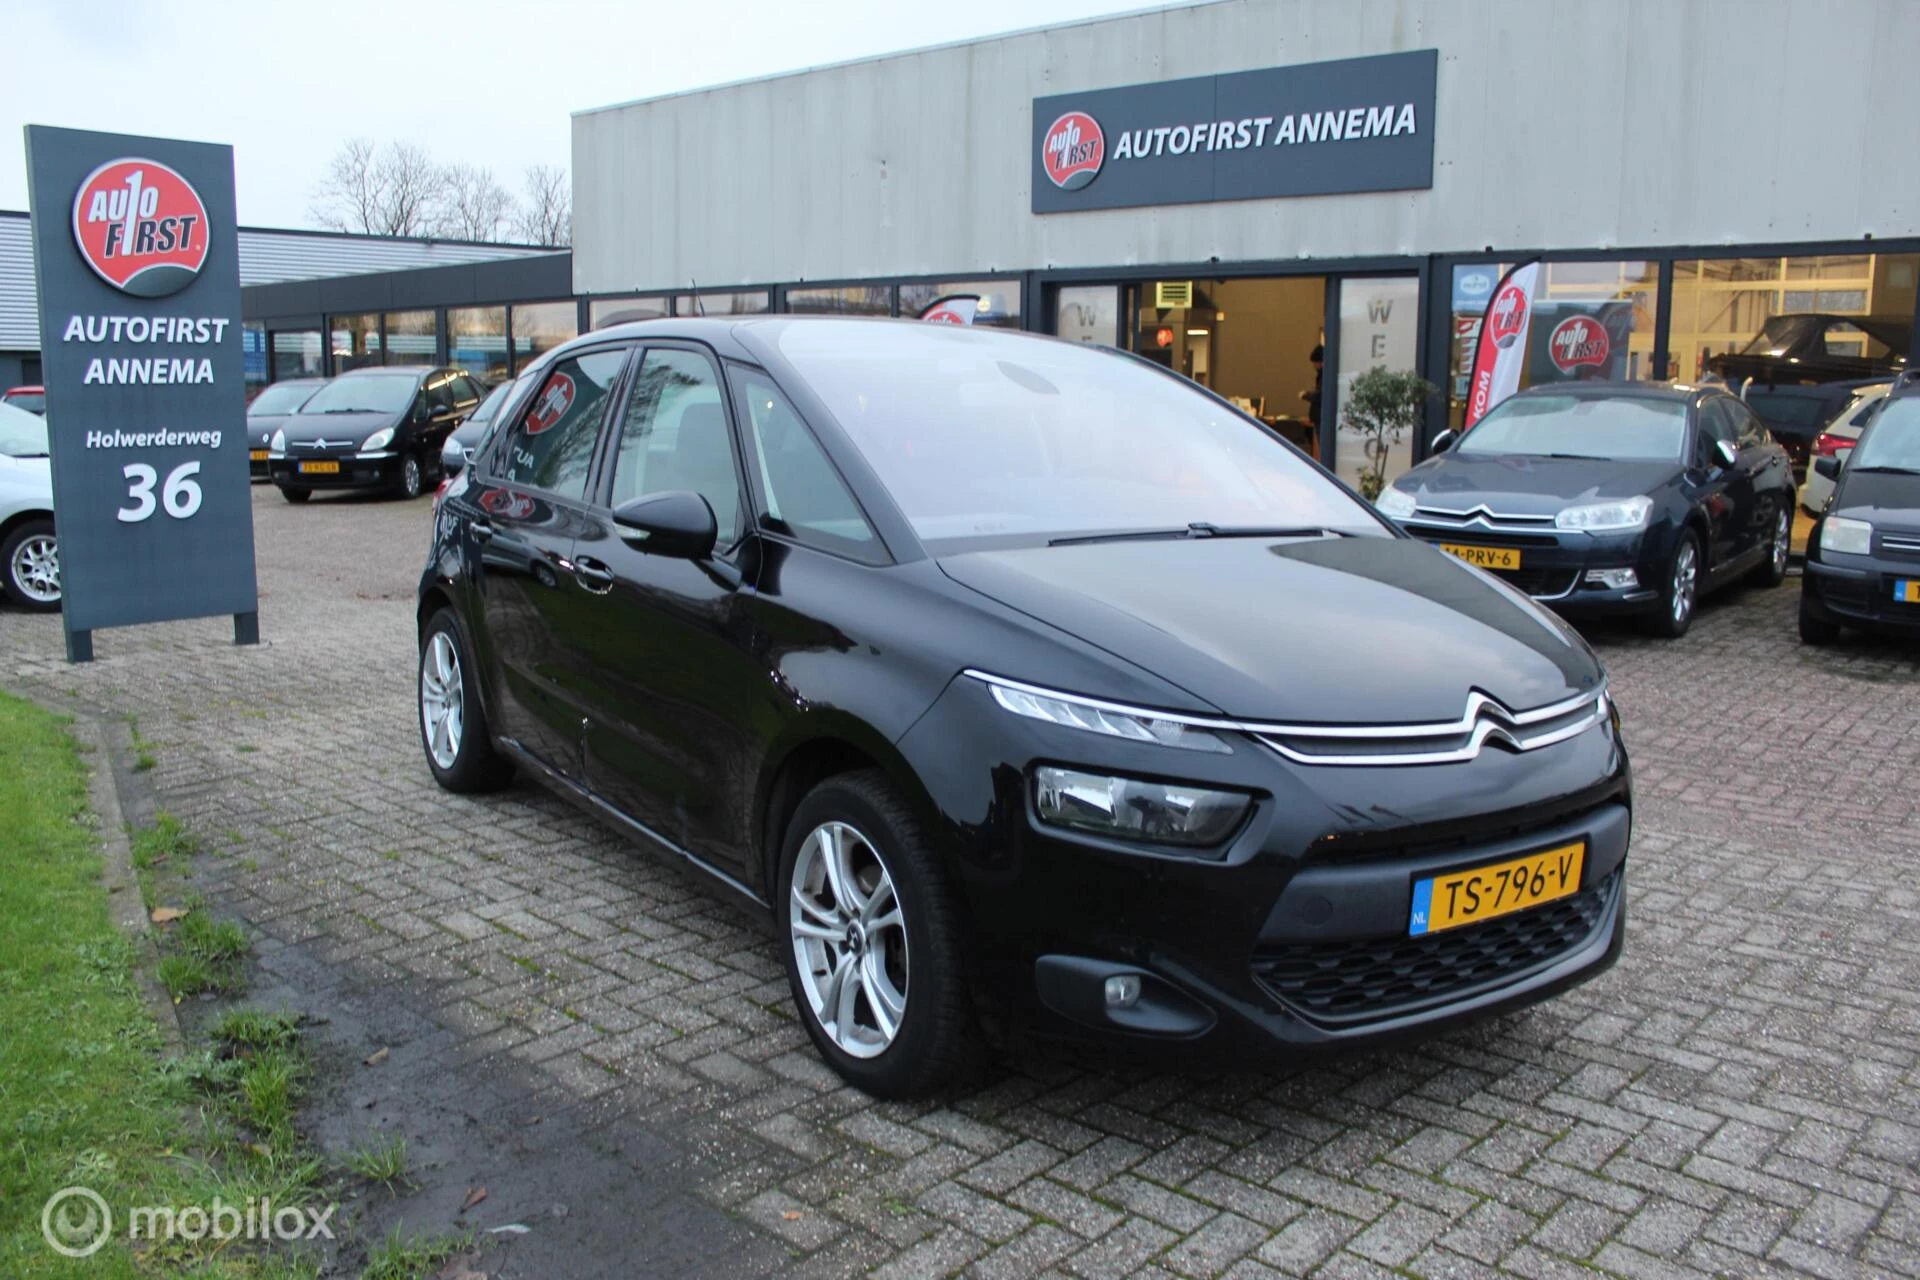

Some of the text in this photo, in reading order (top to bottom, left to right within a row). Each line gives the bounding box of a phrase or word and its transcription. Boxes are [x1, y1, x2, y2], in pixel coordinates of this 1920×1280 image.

[1112, 103, 1417, 160] AUTOFIRST ANNEMA
[63, 315, 229, 344] AUTOFIRST
[83, 358, 215, 385] ANNEMA
[86, 428, 222, 449] Holwerderweg
[117, 460, 203, 523] 36
[1446, 853, 1574, 919] TS-796-V
[1412, 912, 1426, 926] NL
